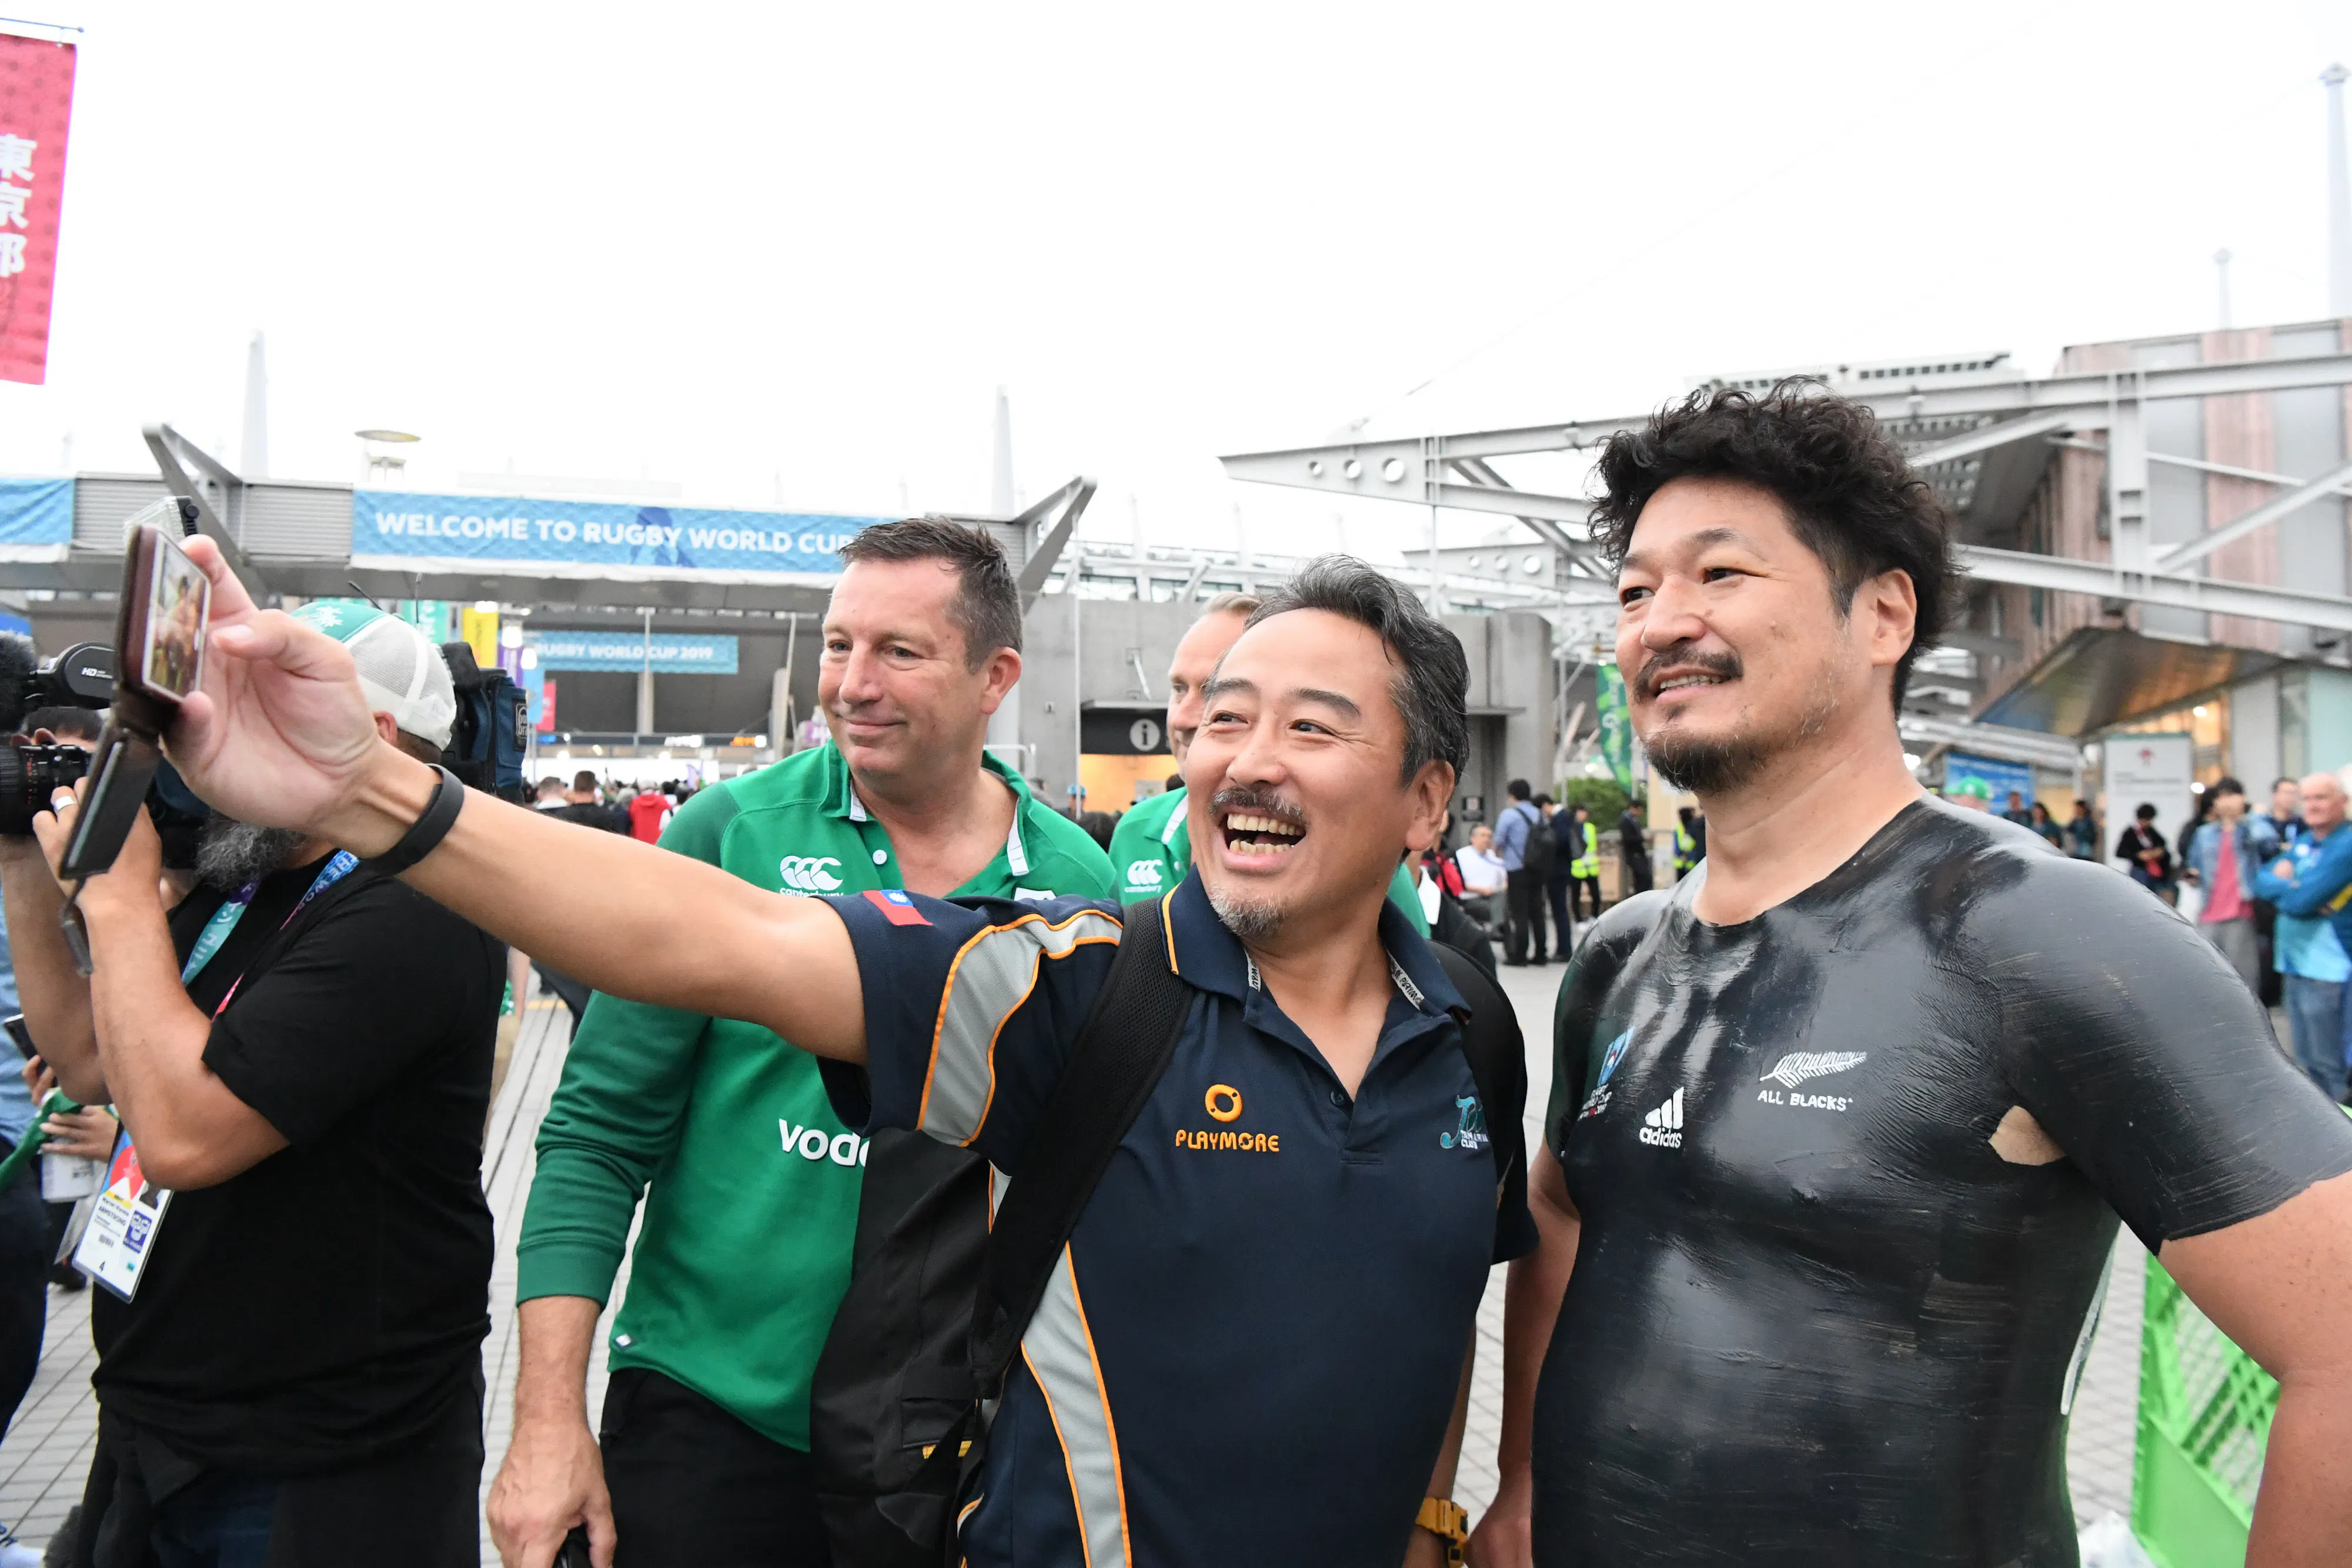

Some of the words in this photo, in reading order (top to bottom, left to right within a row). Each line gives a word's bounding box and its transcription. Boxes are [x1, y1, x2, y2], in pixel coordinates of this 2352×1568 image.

[376, 512, 528, 540] WELCOME
[535, 519, 577, 542] TO
[583, 521, 681, 548] RUGBY
[688, 527, 792, 553] WORLD
[534, 643, 586, 657] RUGBY
[589, 645, 644, 658] WORLD
[649, 646, 677, 659] CUP
[680, 646, 714, 659] 2019
[82, 667, 97, 677] HD
[1757, 1090, 1784, 1105] ALL
[1790, 1093, 1847, 1111] BLACKS
[1176, 1129, 1279, 1152] PLAYMORE
[1639, 1127, 1682, 1148] adidas
